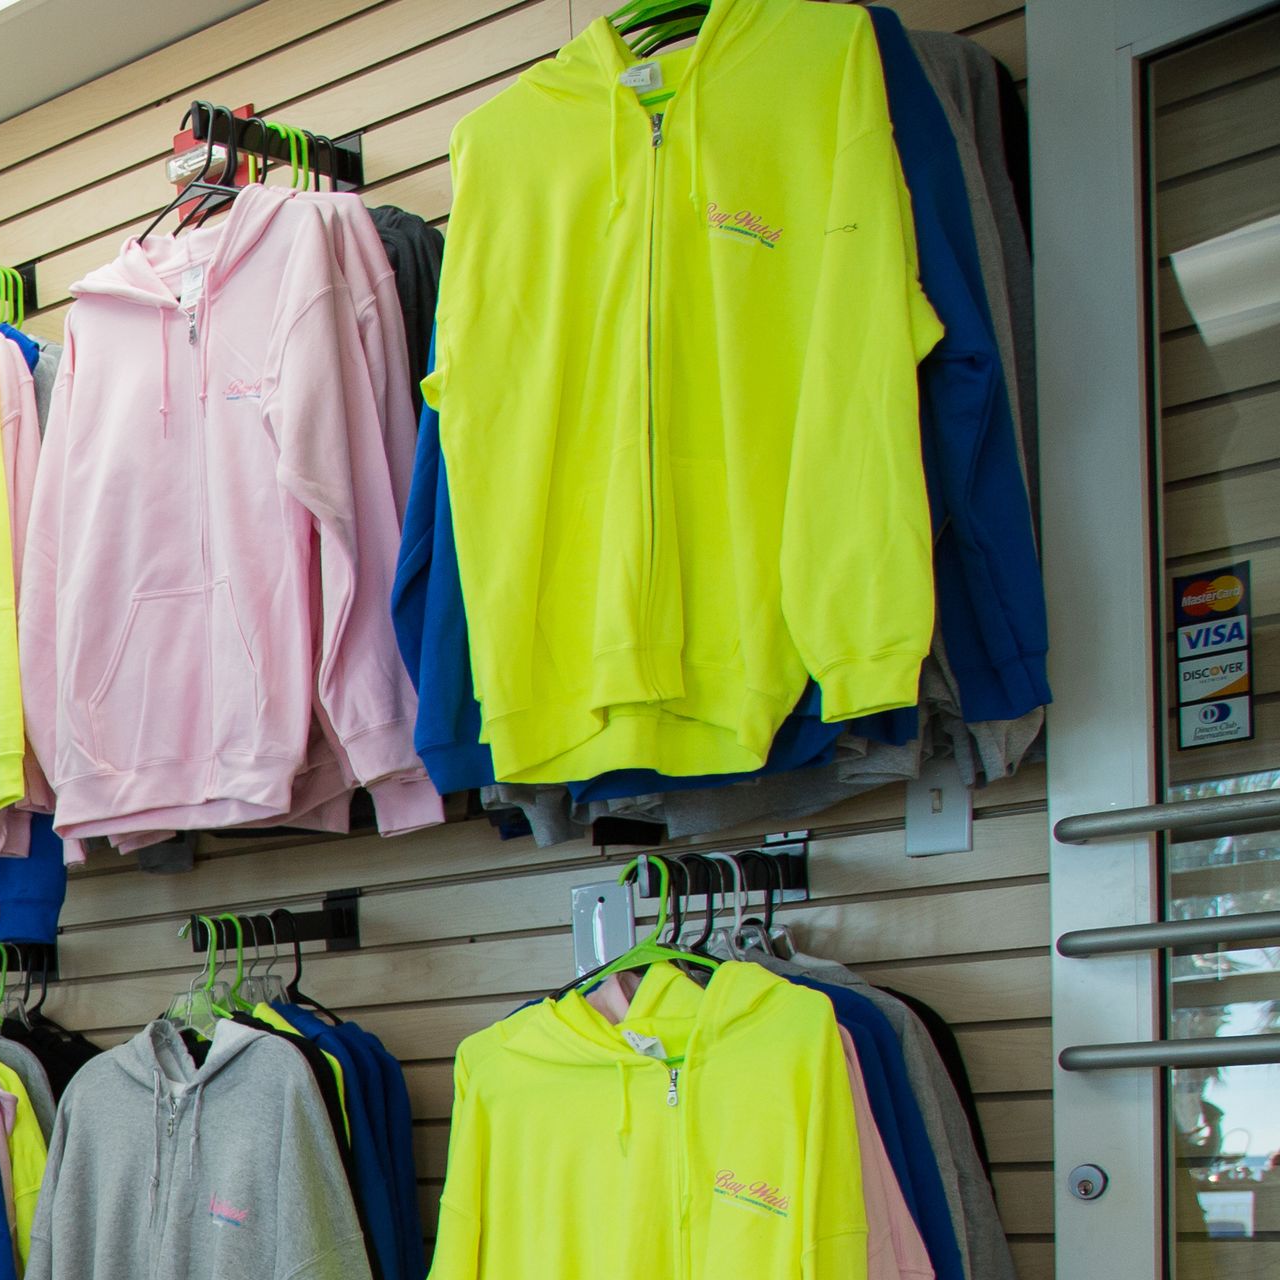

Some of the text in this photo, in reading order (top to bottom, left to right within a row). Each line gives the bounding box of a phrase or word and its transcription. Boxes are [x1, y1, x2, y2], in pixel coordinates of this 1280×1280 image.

[734, 210, 783, 242] Watch
[1181, 585, 1241, 607] MasterCard
[1184, 621, 1244, 650] VISA
[1183, 662, 1243, 681] DISCOVER
[1194, 720, 1238, 735] Diners Club
[715, 1170, 746, 1197] Bay
